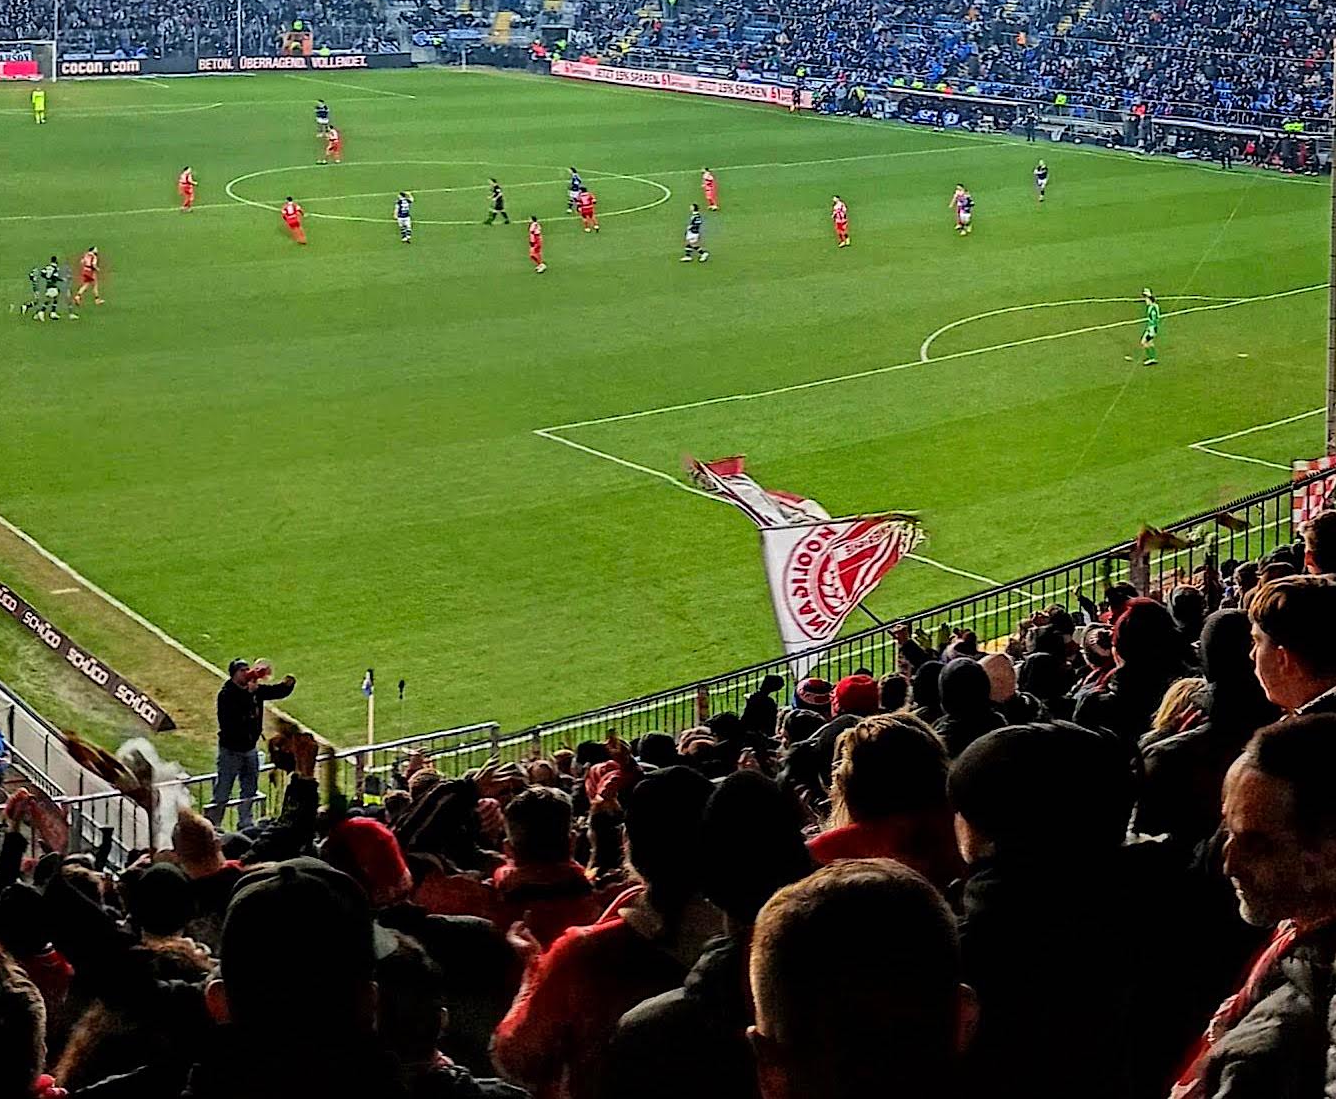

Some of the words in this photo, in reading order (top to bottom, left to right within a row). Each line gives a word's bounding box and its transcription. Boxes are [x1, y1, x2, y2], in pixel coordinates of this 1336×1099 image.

[61, 61, 140, 75] cocon.com
[198, 58, 234, 71] BETON.
[311, 56, 368, 68] VOLLENDET.
[22, 610, 62, 650] SCHÜCO
[66, 646, 110, 687] SCHÜCO
[114, 684, 158, 725] SCHÜCO
